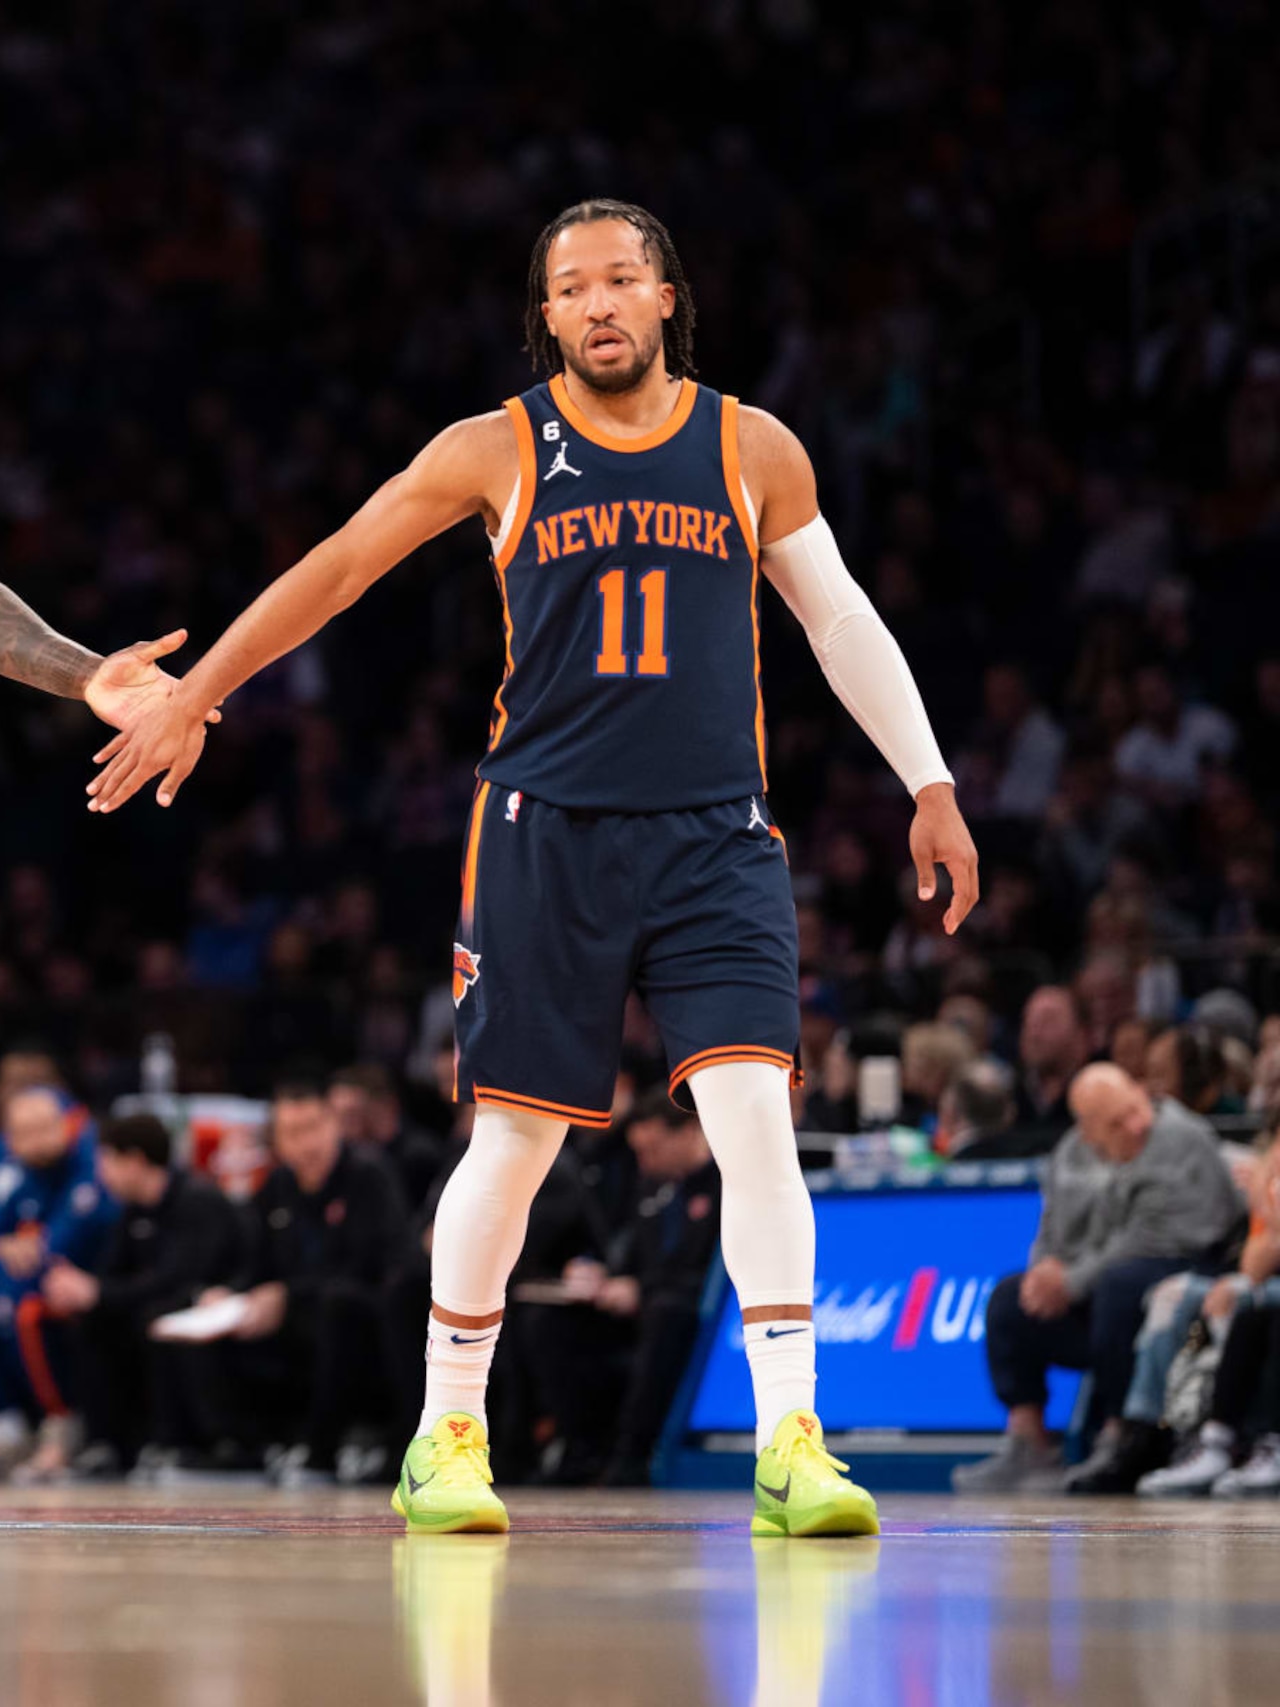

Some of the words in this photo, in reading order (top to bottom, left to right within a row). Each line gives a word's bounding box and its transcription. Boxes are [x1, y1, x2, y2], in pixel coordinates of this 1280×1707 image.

[542, 420, 561, 441] 6
[533, 501, 624, 565] NEW
[627, 500, 731, 560] YORK
[593, 566, 671, 678] 11
